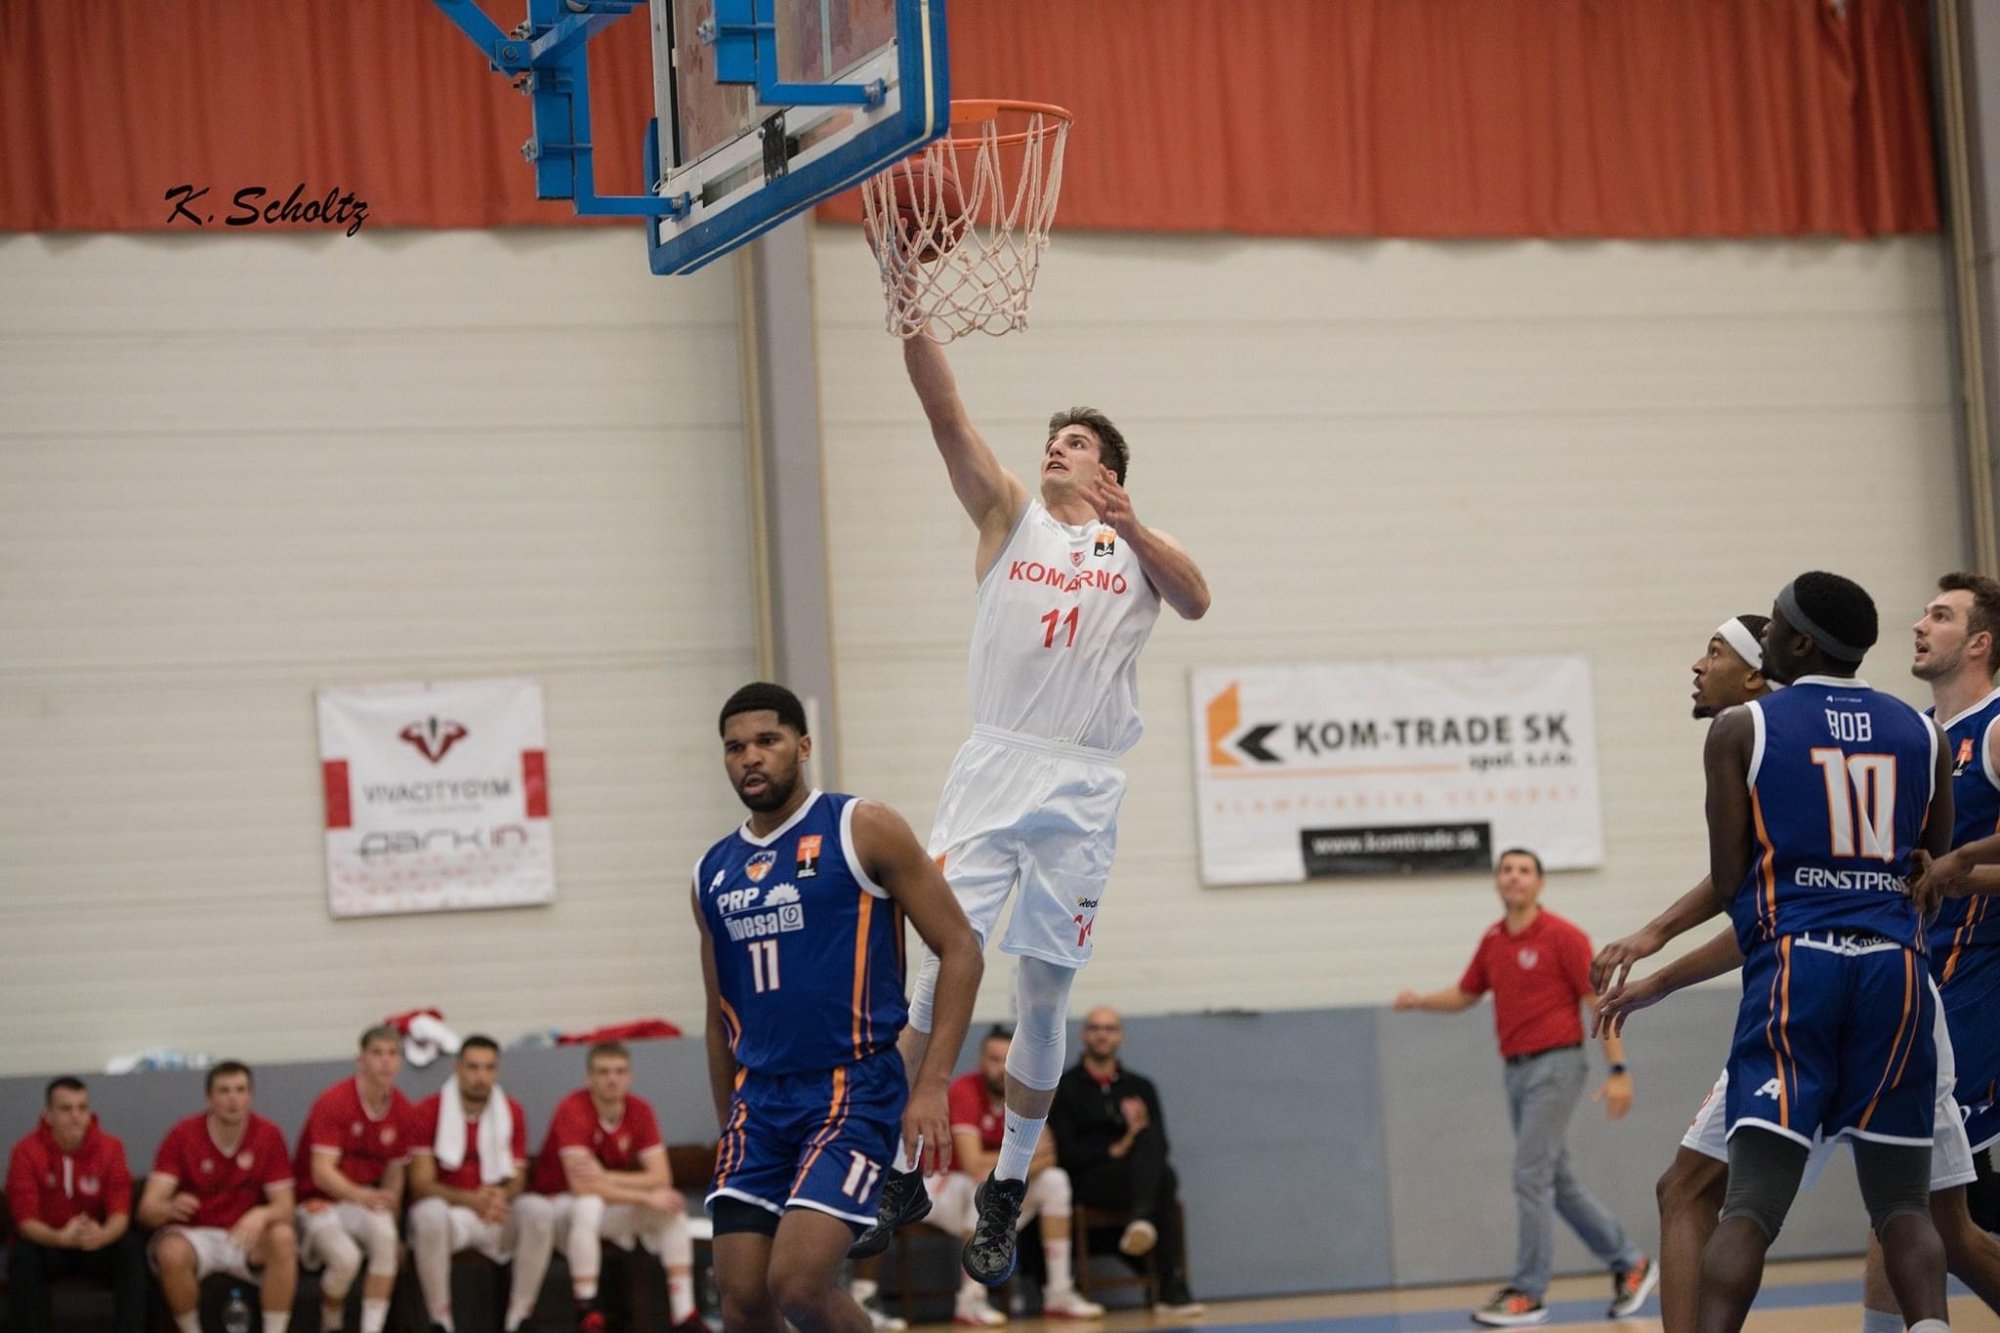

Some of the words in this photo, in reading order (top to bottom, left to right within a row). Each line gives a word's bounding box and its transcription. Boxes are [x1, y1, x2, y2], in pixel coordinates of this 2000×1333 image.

[1041, 606, 1079, 648] 11
[1294, 714, 1511, 756] KOM-TRADE
[1523, 710, 1572, 747] SK
[1825, 708, 1872, 742] BOB
[1810, 747, 1897, 864] 10
[717, 887, 760, 915] PRP
[748, 939, 781, 994] 11
[841, 1149, 882, 1205] 11
